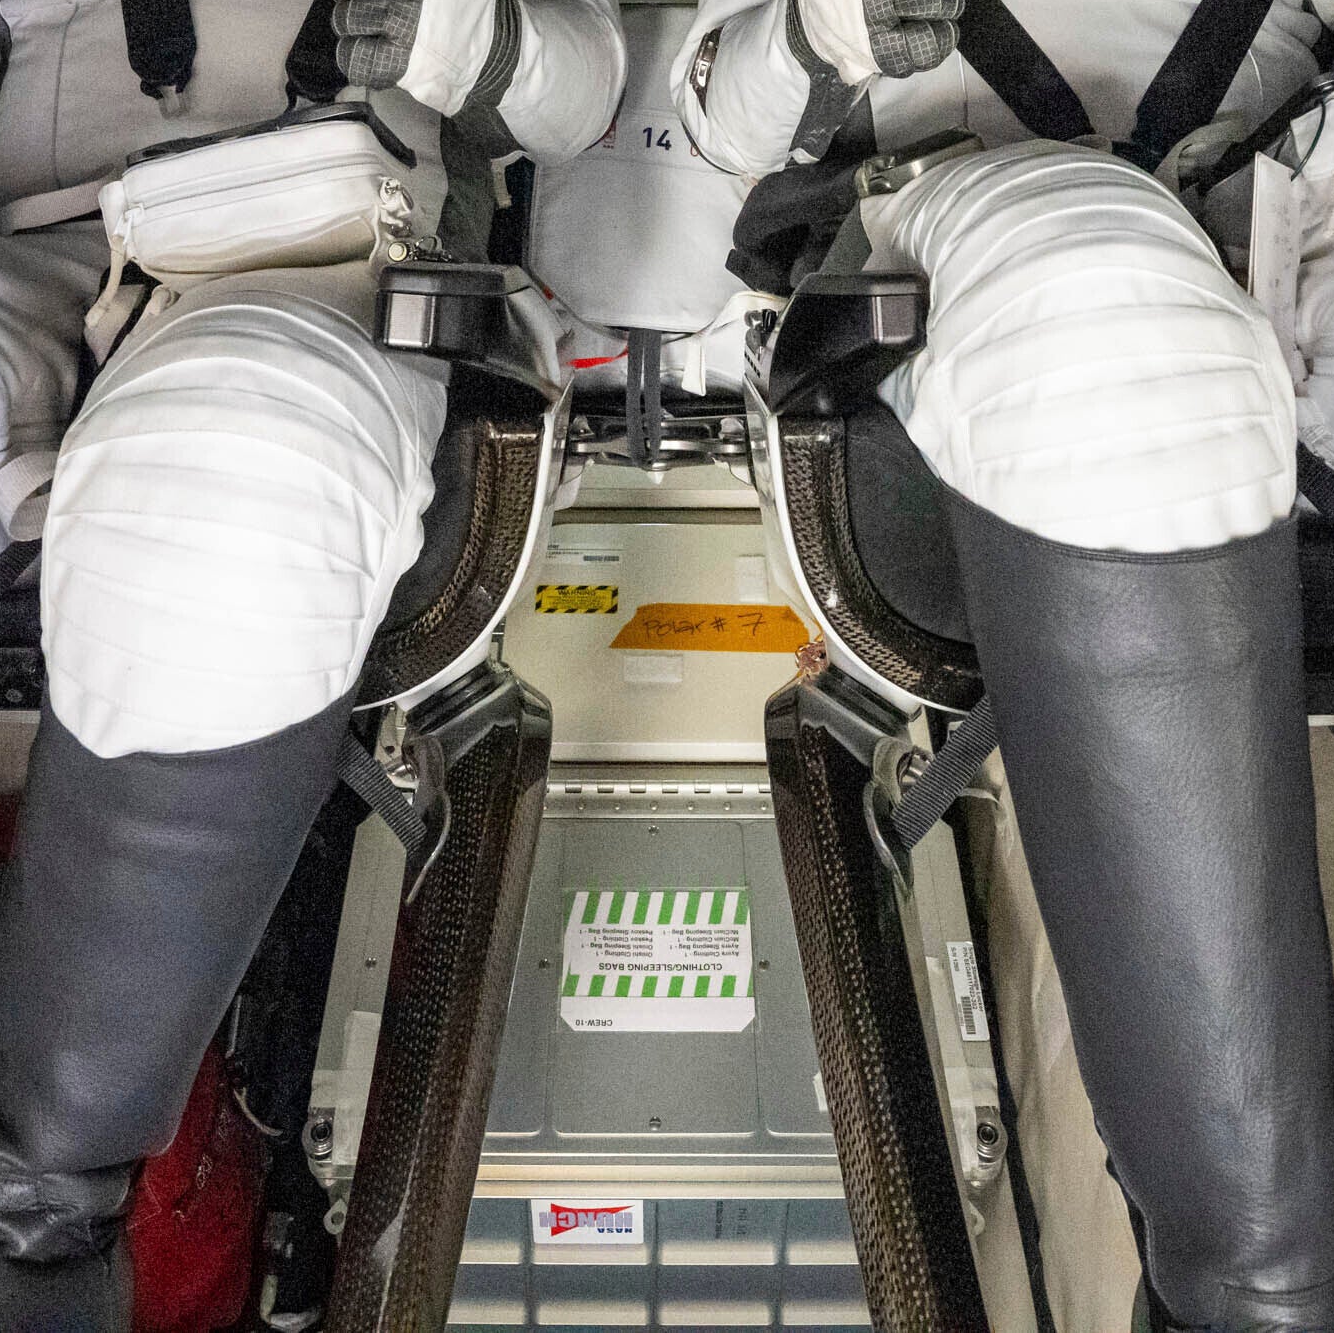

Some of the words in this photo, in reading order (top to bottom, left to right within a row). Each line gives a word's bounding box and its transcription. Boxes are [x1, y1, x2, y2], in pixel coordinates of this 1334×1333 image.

[642, 126, 672, 151] 14
[710, 616, 727, 633] #
[737, 612, 766, 637] 7
[539, 1212, 633, 1227] HUNCH
